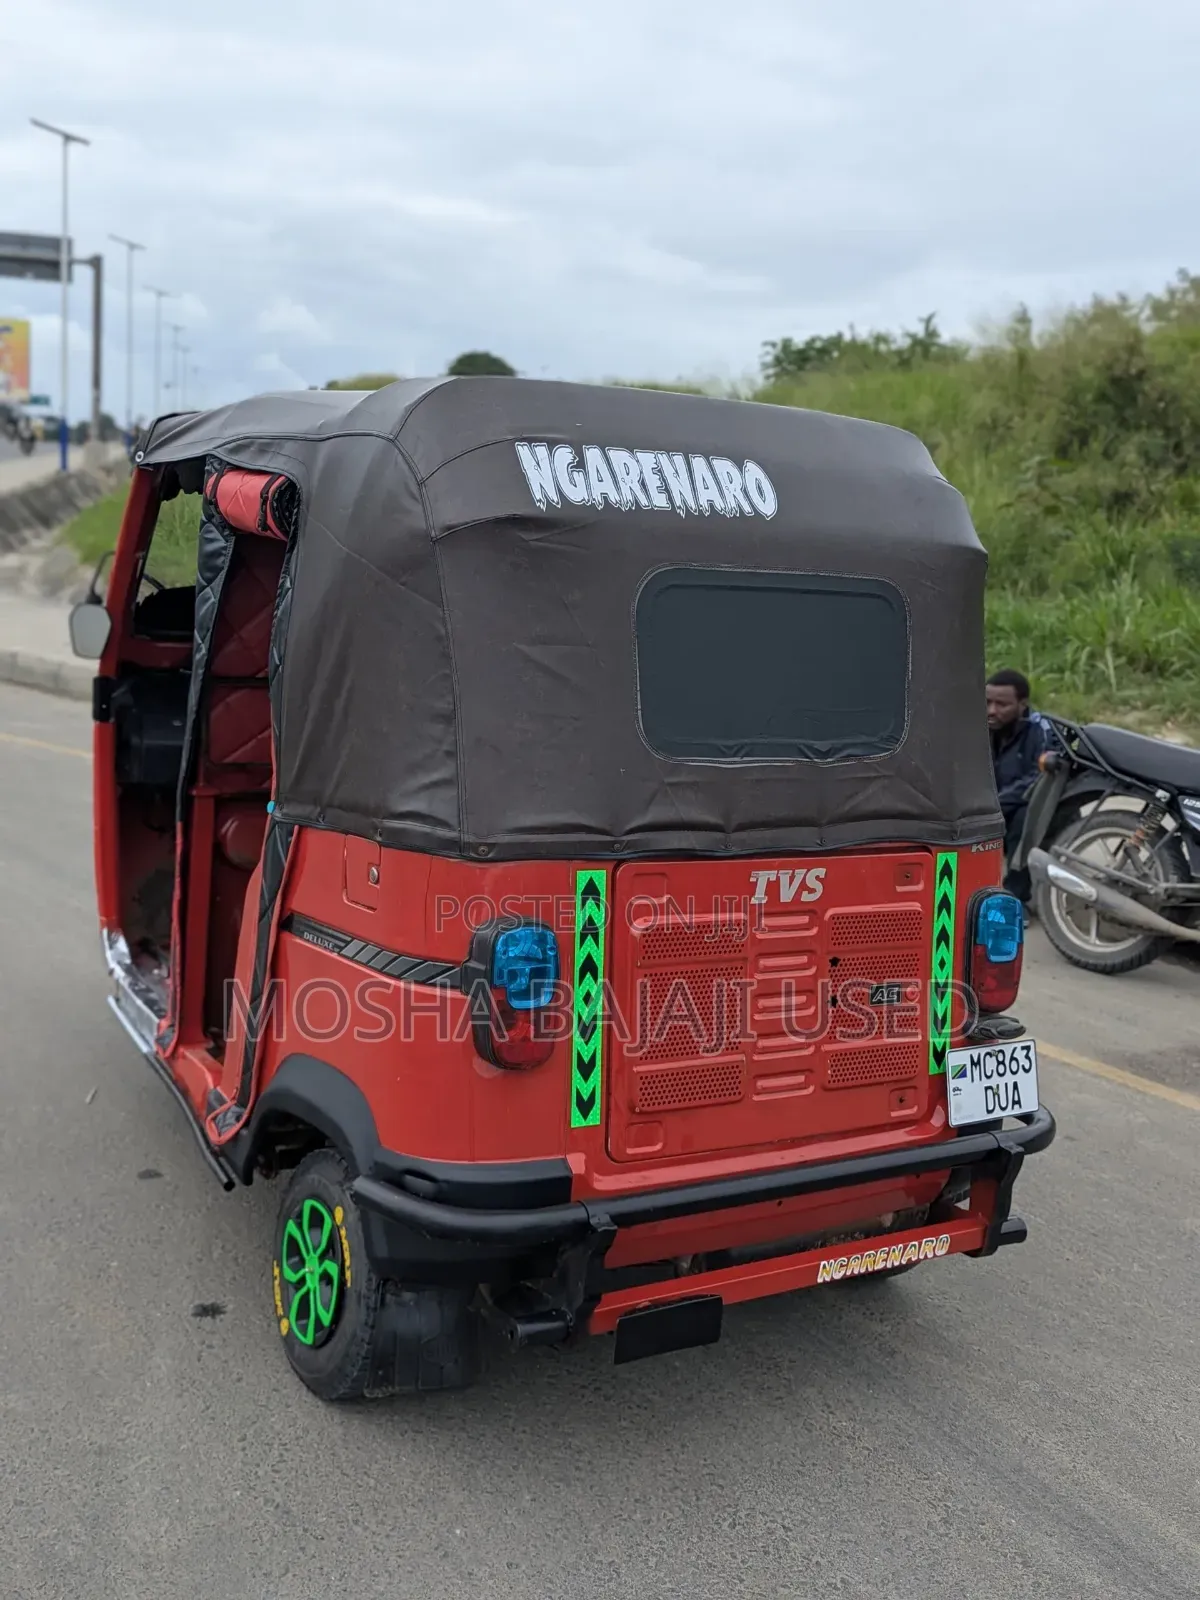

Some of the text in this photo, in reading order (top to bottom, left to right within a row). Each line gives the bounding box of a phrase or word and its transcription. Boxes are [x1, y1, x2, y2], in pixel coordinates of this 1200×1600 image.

[515, 442, 778, 520] NGARENARO
[749, 868, 827, 904] TVS
[303, 931, 335, 950] DELUXE
[969, 1044, 1033, 1083] MC863
[984, 1080, 1022, 1115] DUA
[816, 1233, 951, 1283] NGARENARO
